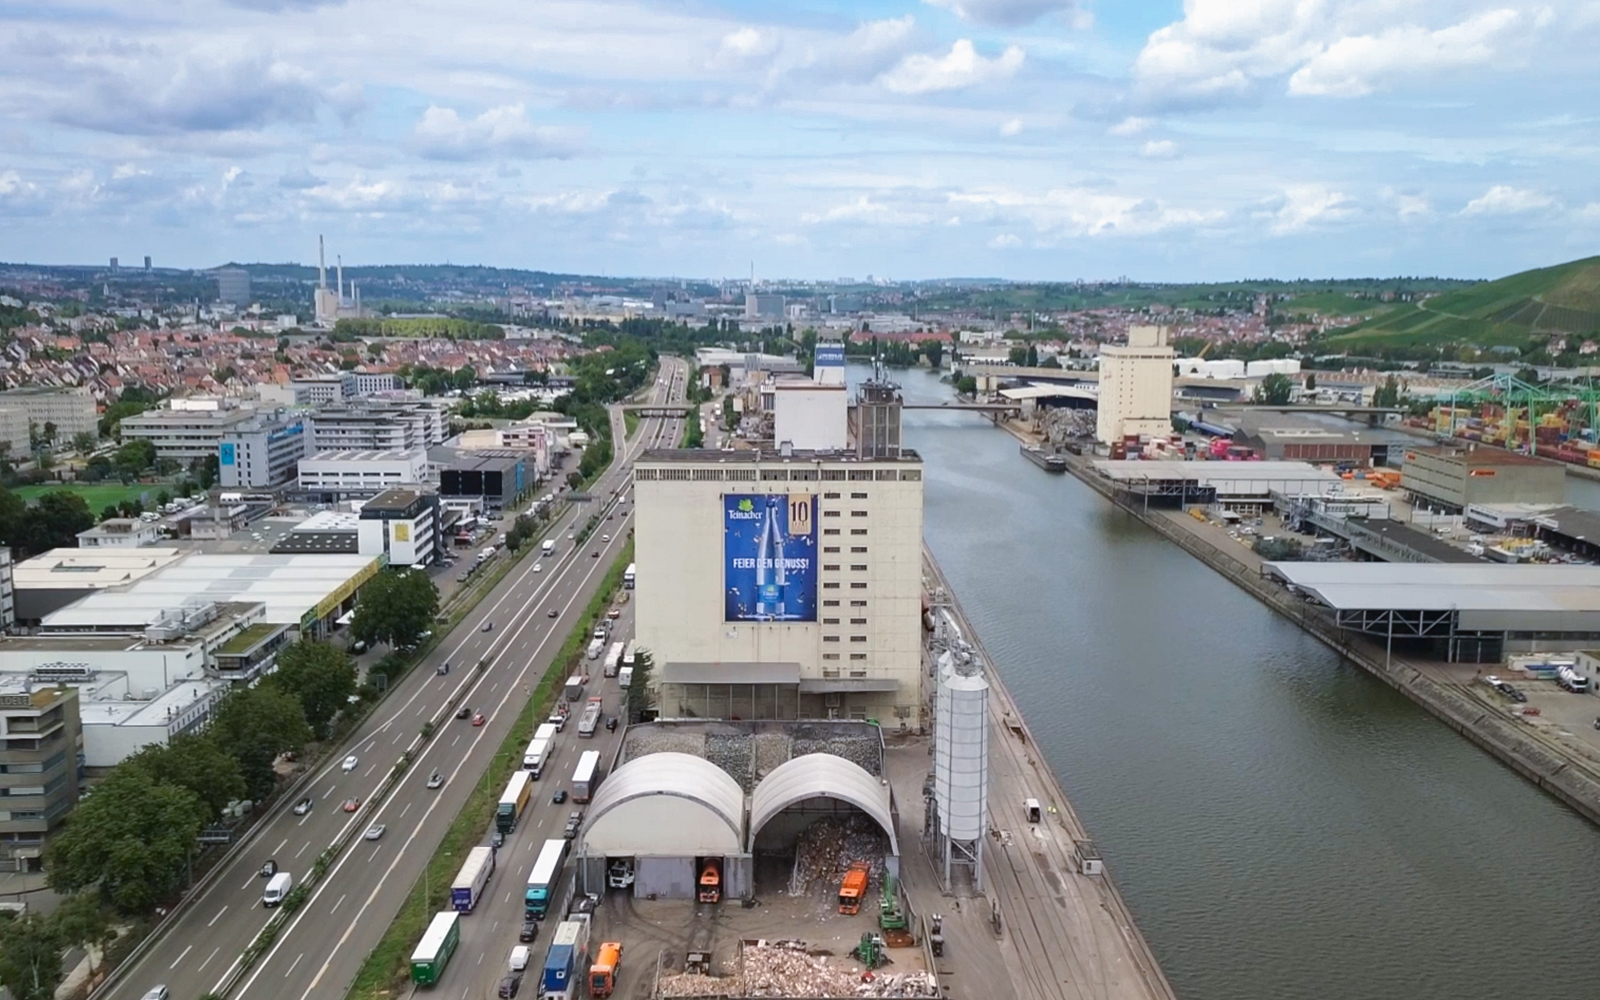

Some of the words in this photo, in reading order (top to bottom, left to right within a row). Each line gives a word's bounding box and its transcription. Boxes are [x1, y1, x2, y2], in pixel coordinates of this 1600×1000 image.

[728, 509, 763, 520] Teinacher
[790, 501, 808, 522] 10
[733, 558, 756, 569] FEIER
[757, 558, 773, 569] DEN
[774, 558, 810, 569] GENUSS!
